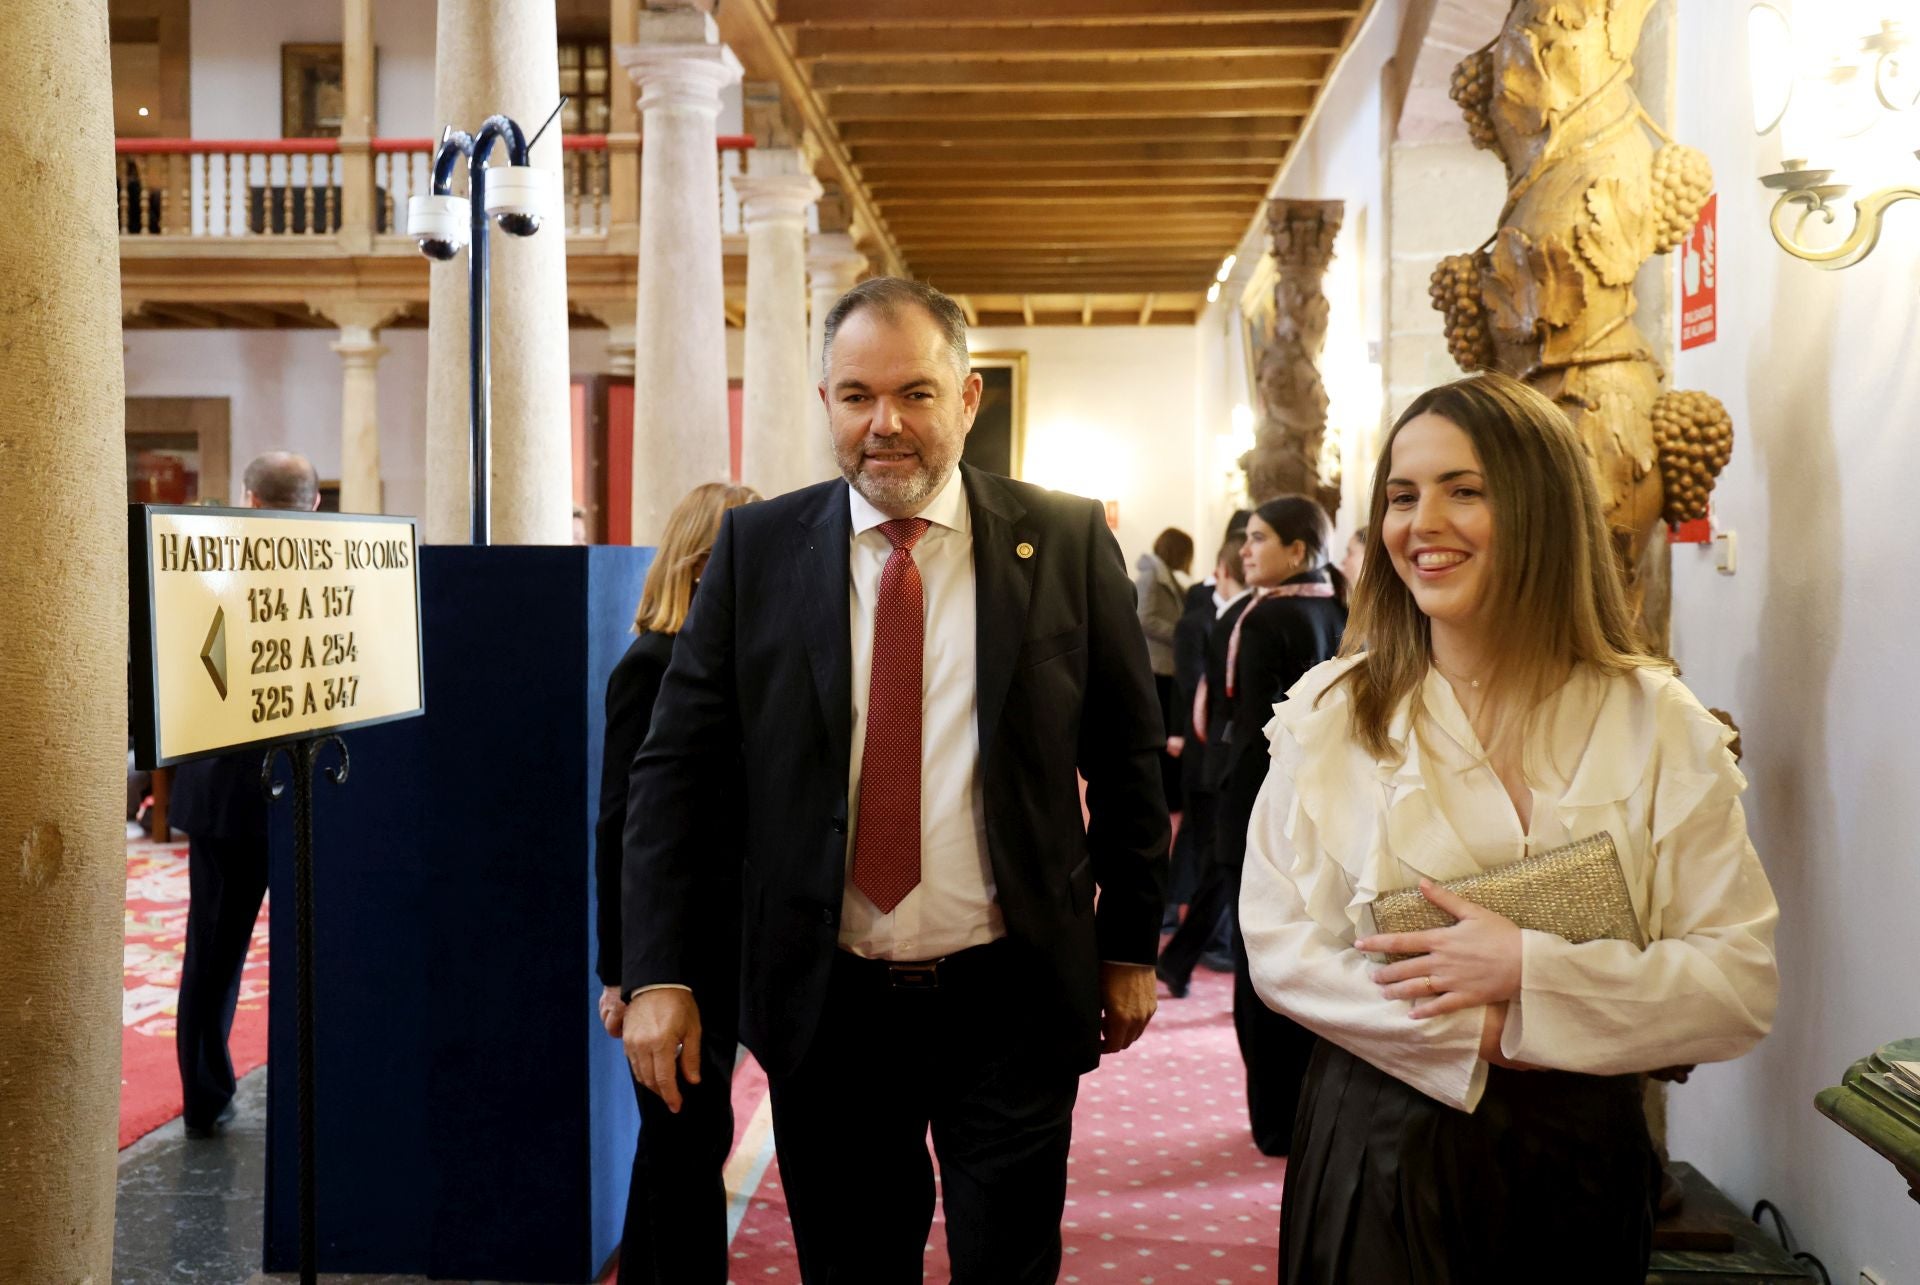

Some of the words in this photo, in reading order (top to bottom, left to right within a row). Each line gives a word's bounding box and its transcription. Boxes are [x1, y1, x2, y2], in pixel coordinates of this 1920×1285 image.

[248, 587, 289, 623] 134
[298, 587, 315, 620] A
[322, 585, 356, 618] 157
[250, 638, 292, 675] 228
[300, 636, 316, 669] A
[322, 632, 358, 666] 254
[251, 684, 294, 723] 325
[302, 682, 318, 716] A
[323, 675, 360, 710] 347
